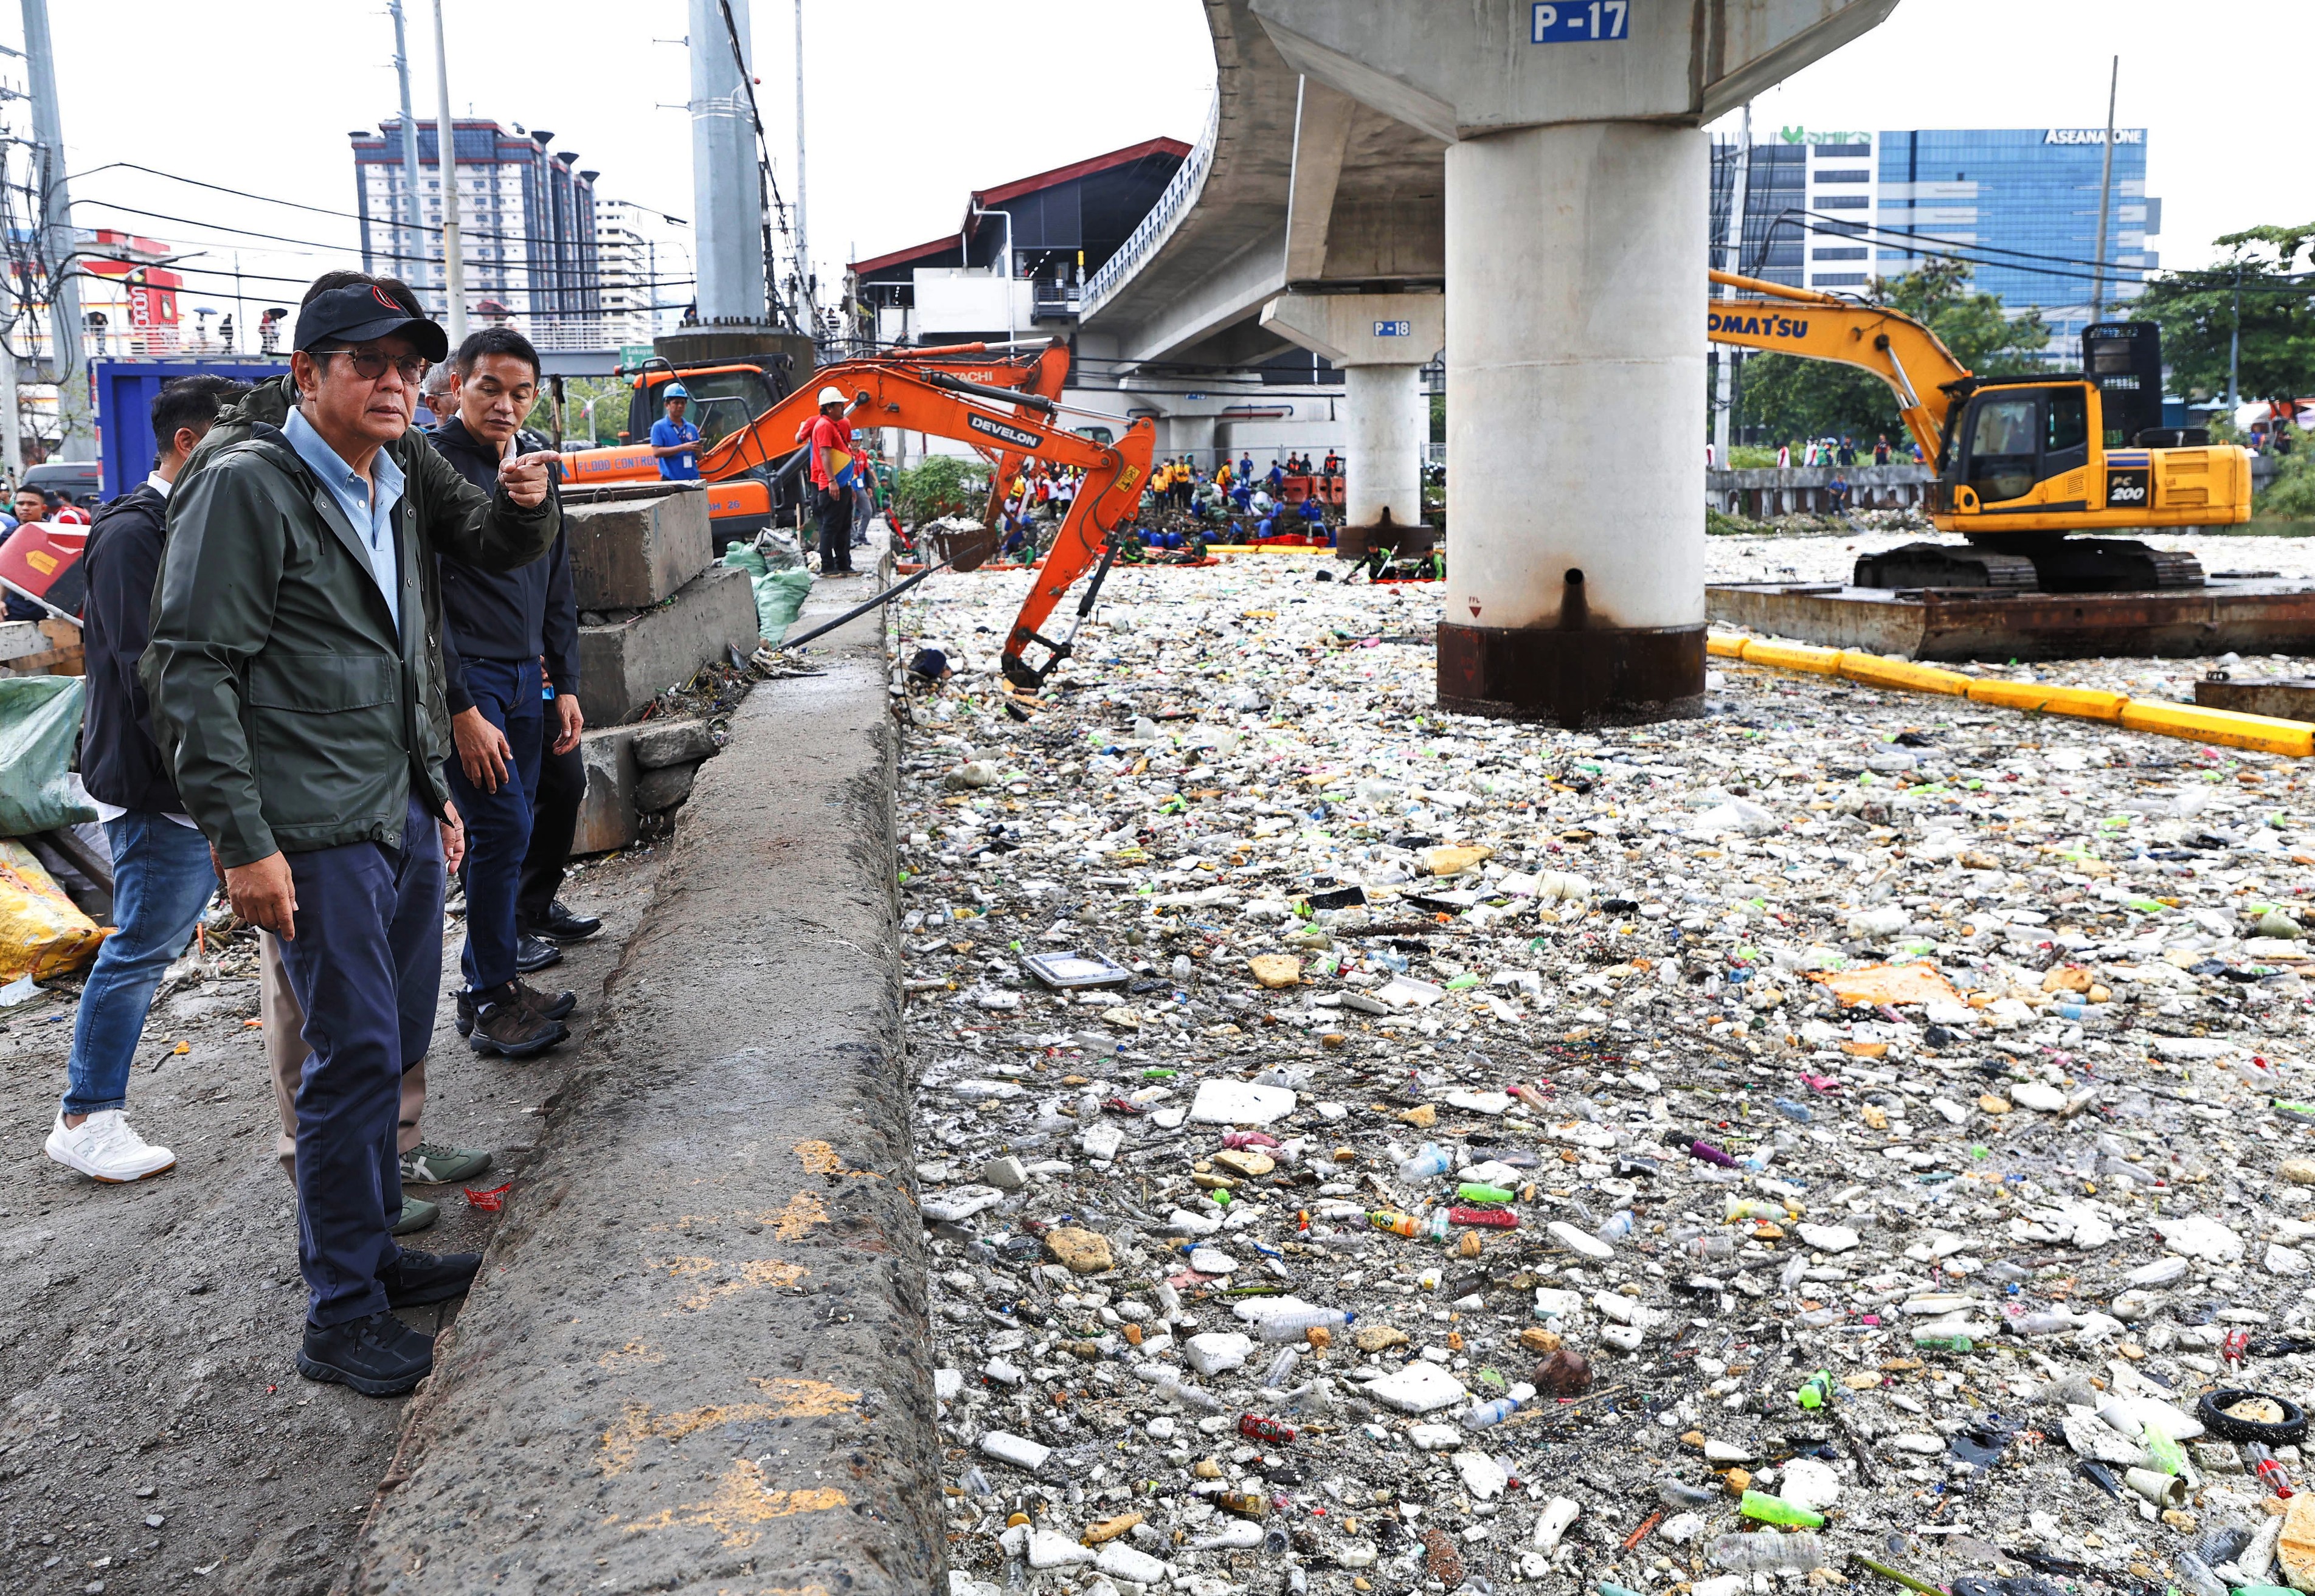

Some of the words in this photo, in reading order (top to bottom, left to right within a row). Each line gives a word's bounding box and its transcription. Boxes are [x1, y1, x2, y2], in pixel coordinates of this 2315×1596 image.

[1534, 4, 1557, 42] P
[2041, 129, 2108, 145] ASEANA
[2111, 128, 2142, 145] ONE
[1375, 322, 1385, 336] P
[1708, 313, 1808, 338] OMATSU
[950, 370, 994, 383] TACHI
[971, 416, 1037, 447] DEVELON
[578, 460, 611, 473] FLOOD
[614, 455, 659, 469] CONTROL
[2112, 476, 2133, 486] PC
[2110, 486, 2145, 500] 200
[727, 500, 741, 510] 26
